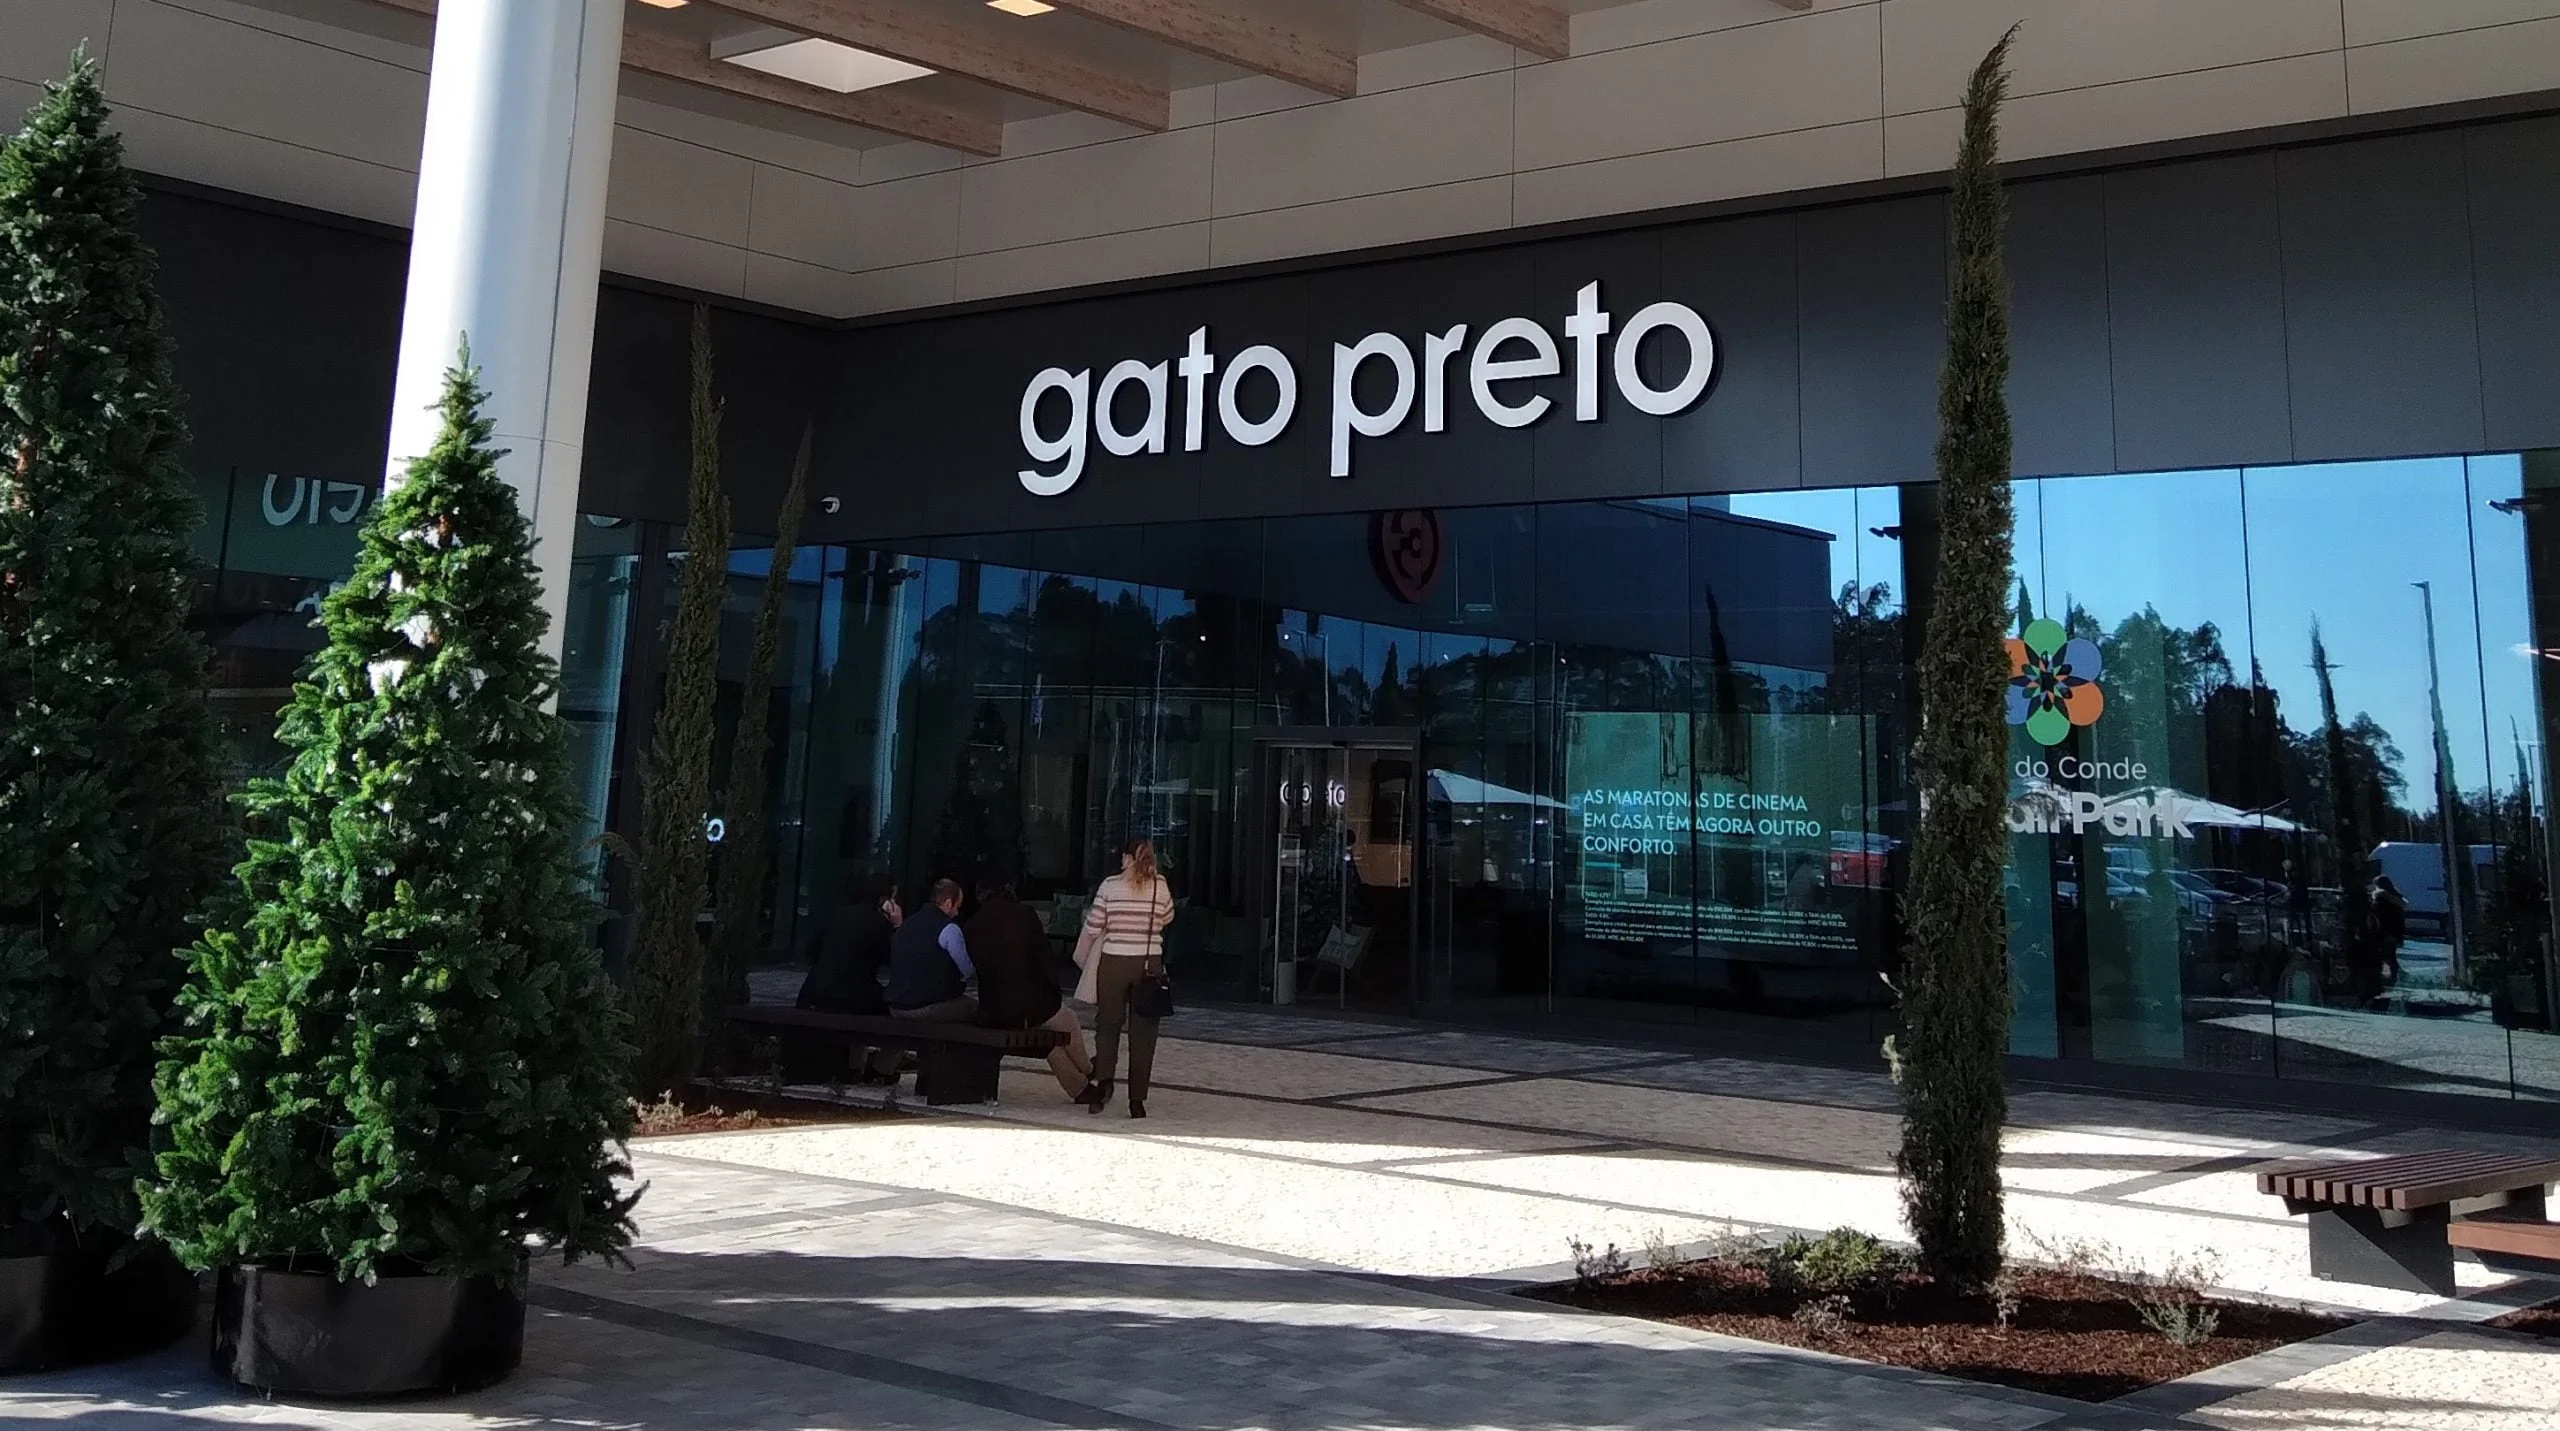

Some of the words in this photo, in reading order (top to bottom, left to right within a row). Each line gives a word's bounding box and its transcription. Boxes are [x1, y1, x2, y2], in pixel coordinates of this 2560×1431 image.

[1018, 324, 1297, 496] gato
[1330, 279, 1714, 478] preto
[2015, 755, 2049, 778] do
[2058, 756, 2147, 780] Conde
[1583, 789, 1604, 805] AS
[1713, 792, 1736, 809] DE
[1739, 793, 1808, 812] CINEMA
[1583, 812, 1607, 828] EM
[1610, 813, 1654, 830] CASA
[1656, 810, 1690, 832] TÊM
[1695, 816, 1756, 836] AGORA
[1758, 818, 1821, 838] OUTRO
[2071, 791, 2194, 839] Park
[1583, 835, 1678, 856] CONFORTO.
